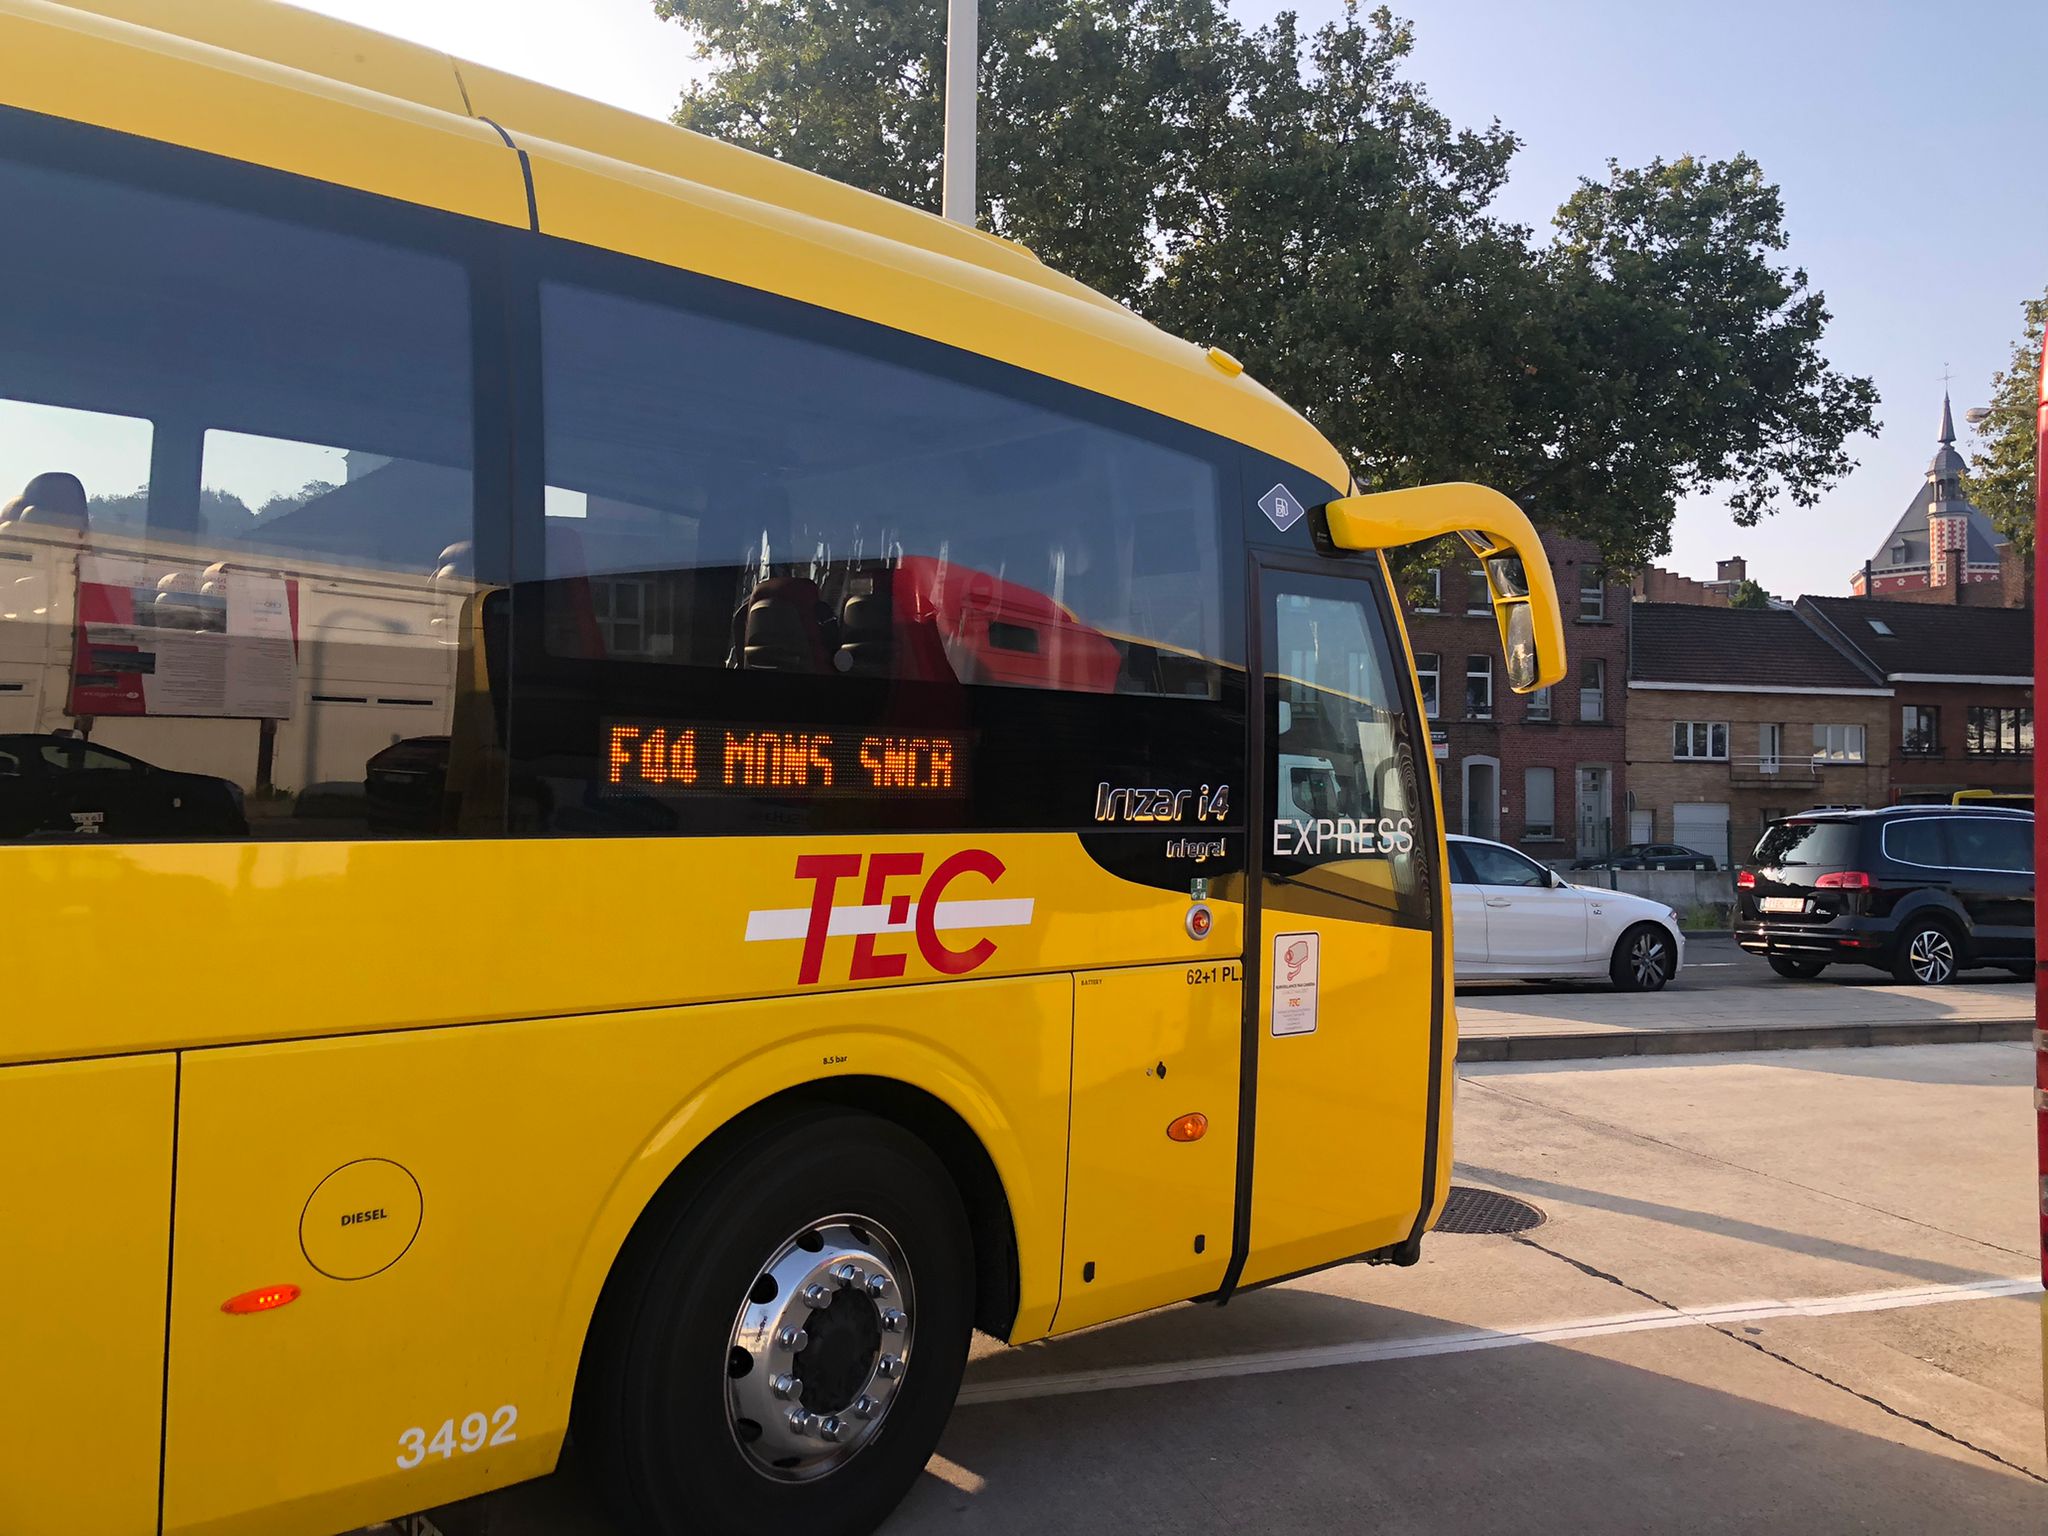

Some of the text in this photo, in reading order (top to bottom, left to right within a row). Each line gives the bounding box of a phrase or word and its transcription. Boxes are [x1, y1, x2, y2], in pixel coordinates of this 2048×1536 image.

[610, 727, 697, 783] F44
[724, 732, 833, 785] MONS
[1095, 782, 1229, 821] Irizar i4
[1166, 837, 1227, 863] Integral
[1273, 817, 1413, 855] EXPRESS
[795, 849, 1006, 985] TEC
[1186, 968, 1217, 985] 62+1
[835, 1055, 848, 1063] bar
[341, 1208, 387, 1227] DIESEL
[396, 1405, 518, 1469] 3492
